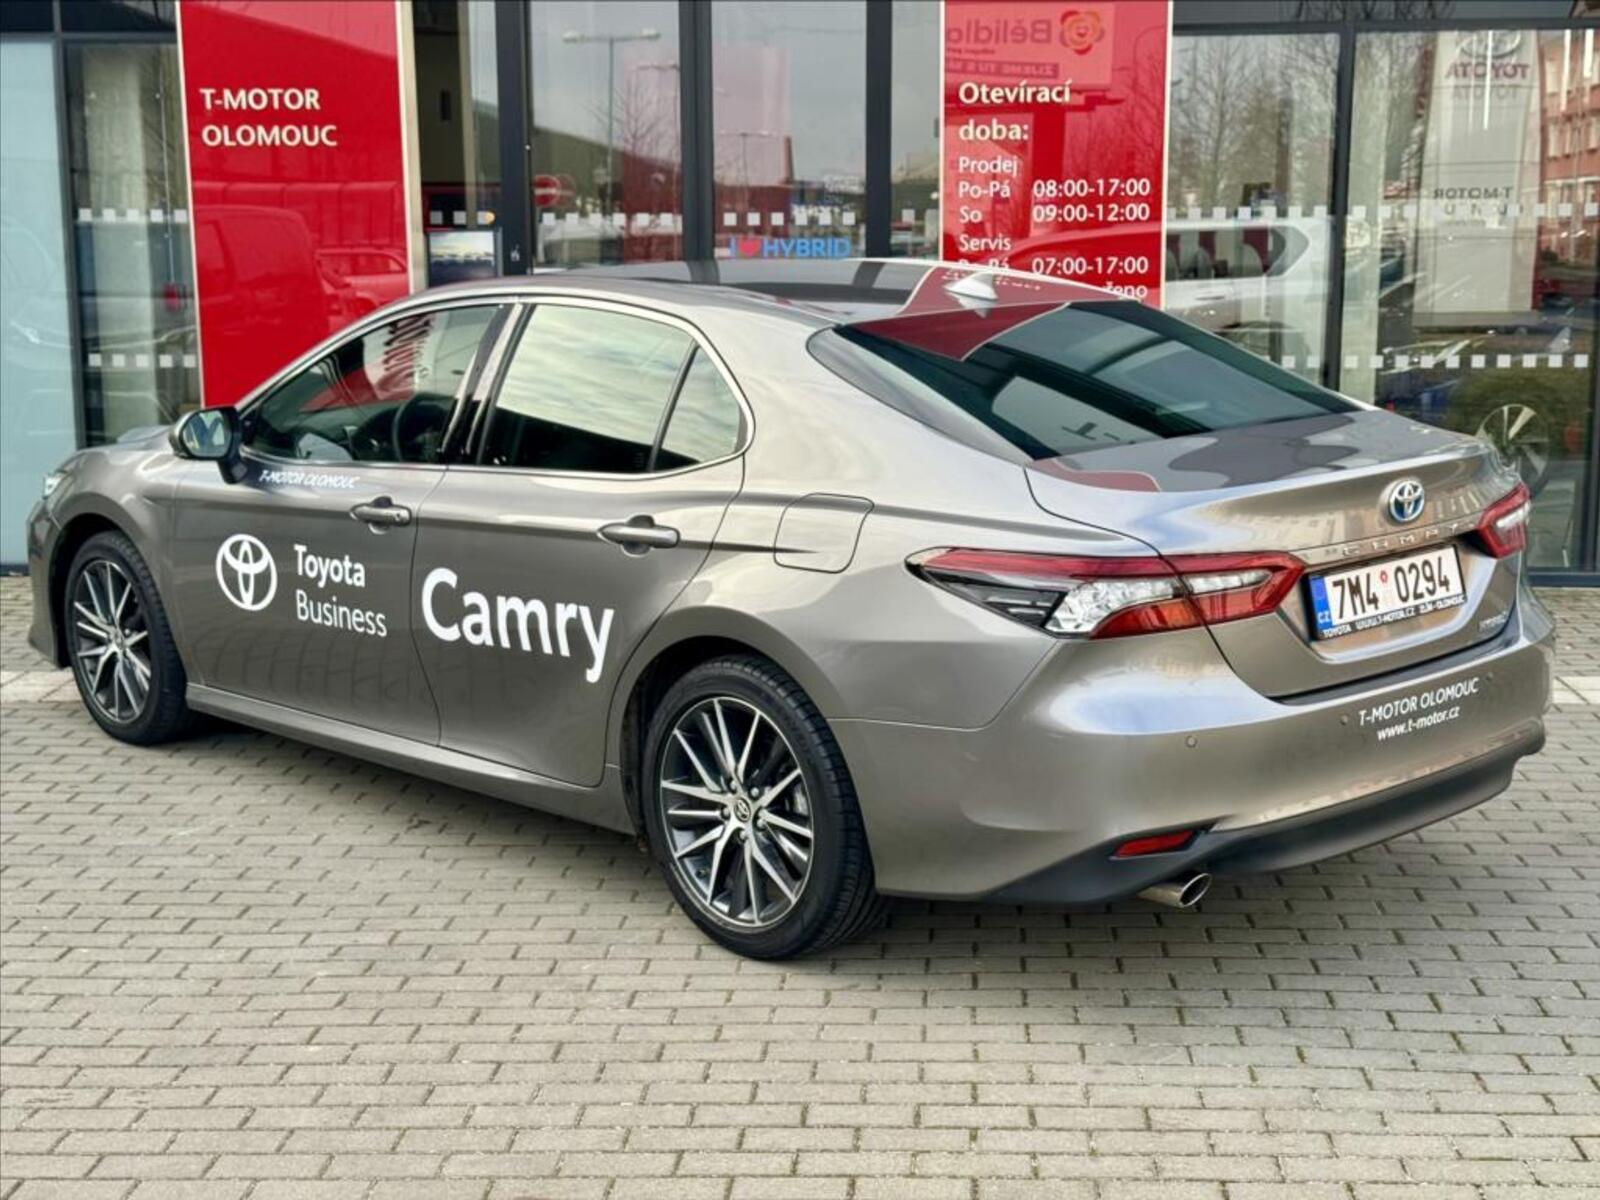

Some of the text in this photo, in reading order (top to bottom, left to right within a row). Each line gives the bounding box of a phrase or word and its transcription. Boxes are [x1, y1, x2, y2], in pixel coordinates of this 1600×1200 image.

[200, 88, 320, 111] T-MOTOR
[959, 80, 1072, 104] Otevírací
[202, 124, 338, 147] OLOMOUC
[959, 119, 1029, 140] doba:
[959, 156, 1018, 176] Prodej
[959, 178, 1150, 199] Po-Pá 08:00-17:00
[960, 203, 1150, 223] So 09:00-12:00
[763, 237, 850, 257] HYBRID
[960, 234, 1012, 251] Servis
[1032, 256, 1148, 275] 07:00-17:00
[294, 543, 366, 588] Toyota
[1332, 556, 1450, 620] 7M4 0294
[295, 589, 388, 637] Business
[1317, 610, 1330, 624] CZ
[422, 567, 614, 683] Camry
[1358, 677, 1480, 727] T-MOTOR OLOMOUC
[1377, 706, 1460, 741] www.t-motor.cz
